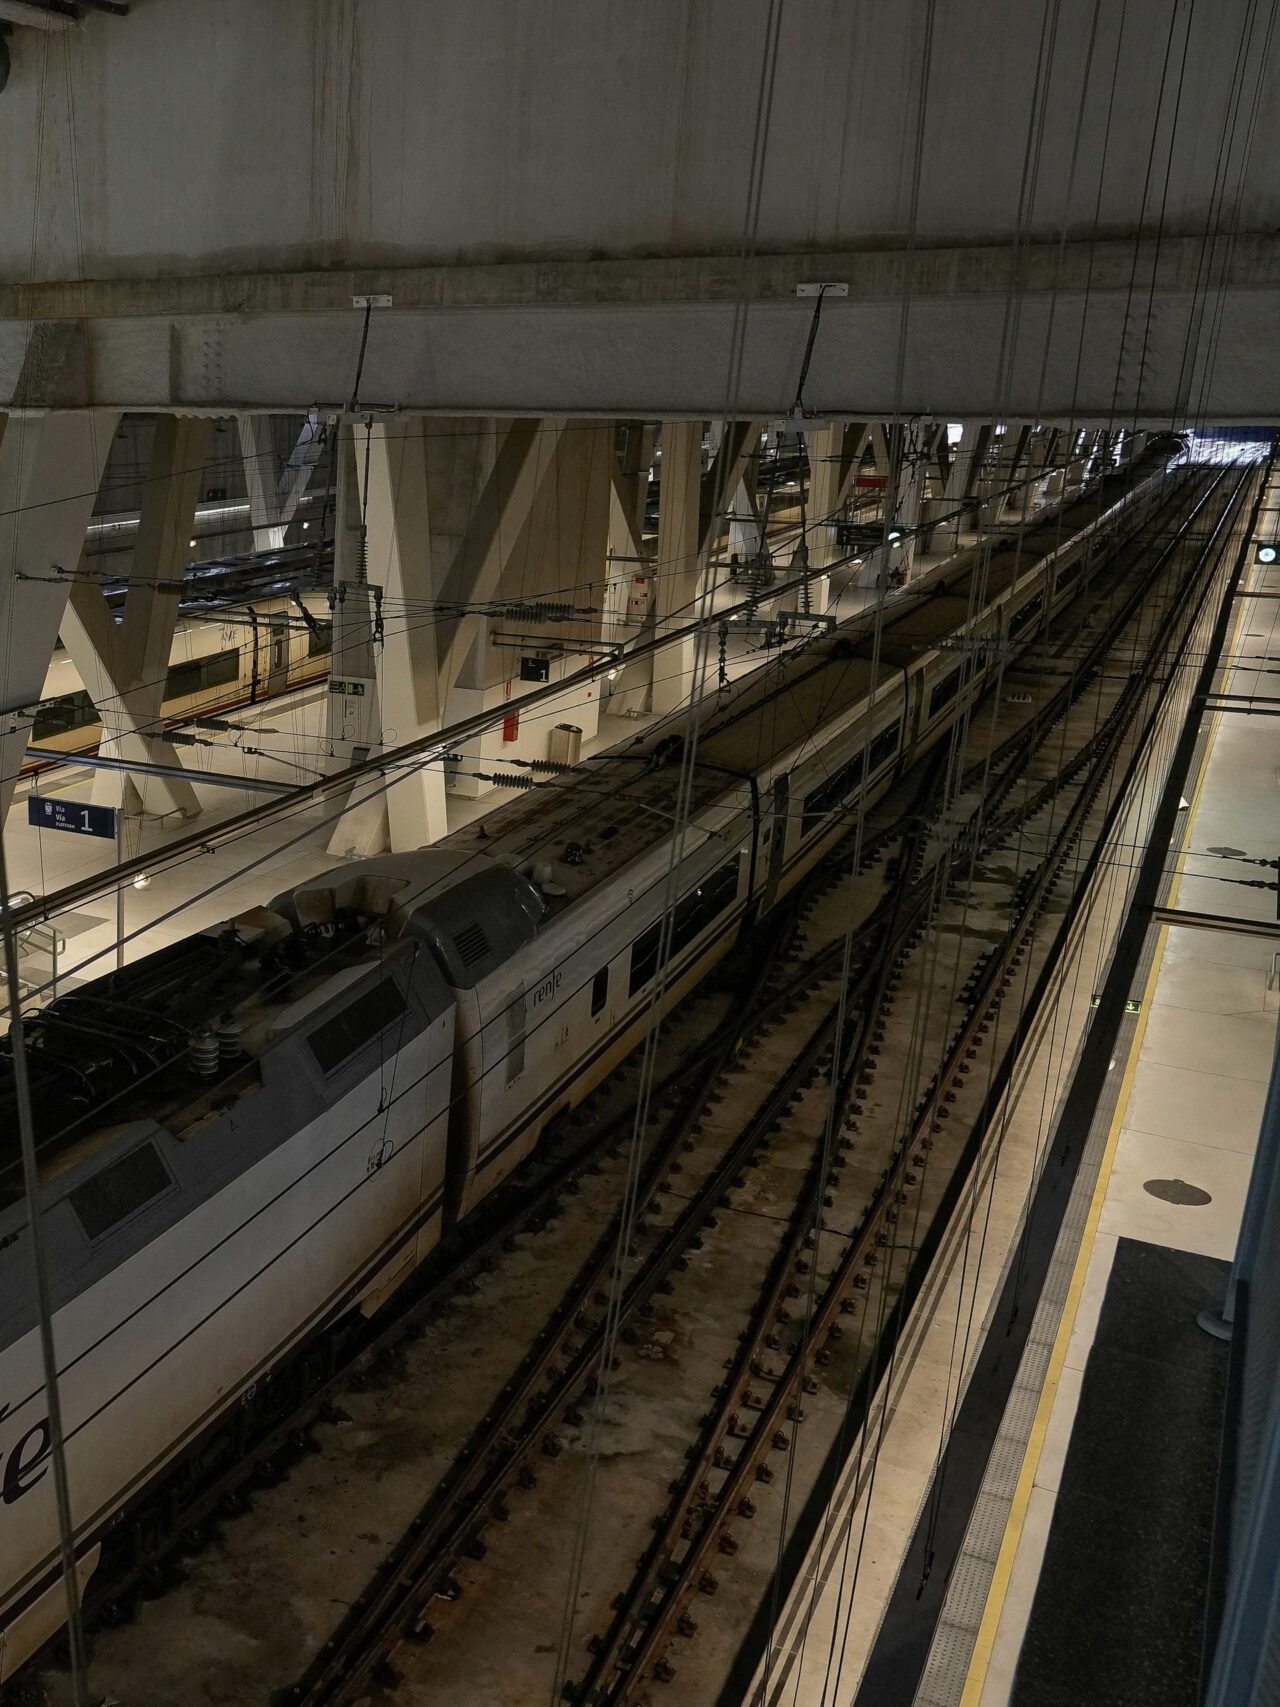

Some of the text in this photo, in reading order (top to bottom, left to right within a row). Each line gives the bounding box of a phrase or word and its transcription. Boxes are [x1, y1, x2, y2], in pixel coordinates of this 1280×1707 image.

[540, 669, 548, 682] 1
[80, 809, 94, 833] 1
[533, 970, 562, 1007] renfe
